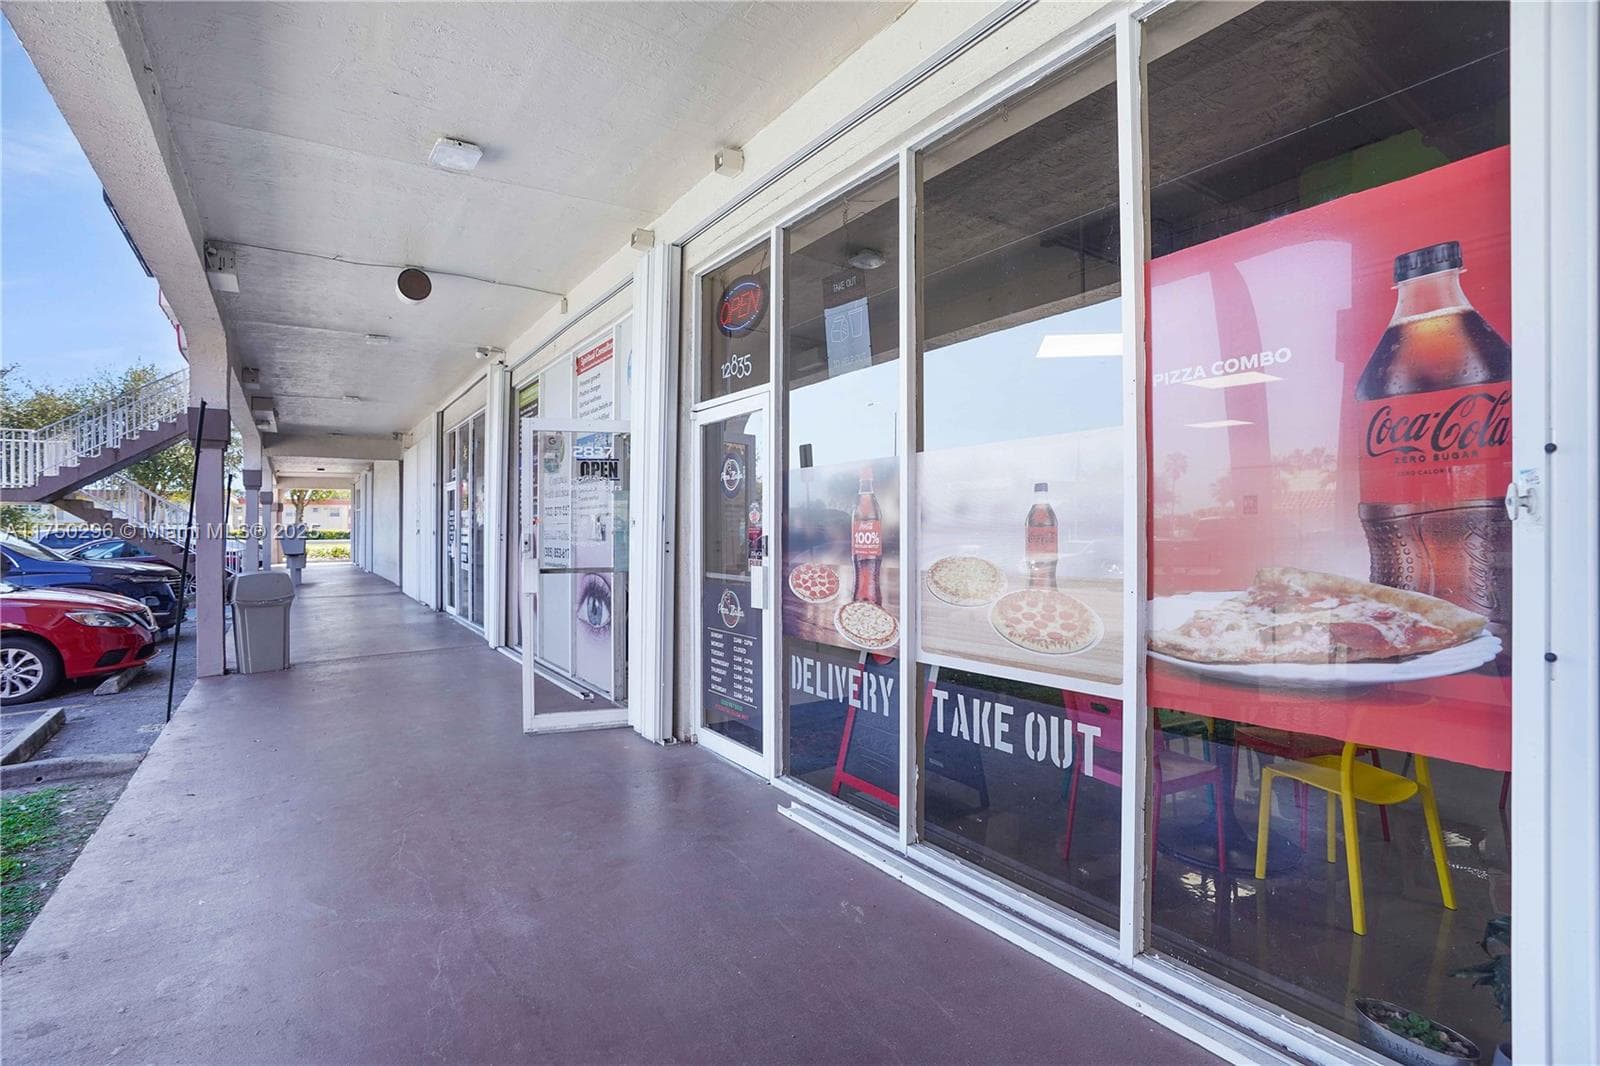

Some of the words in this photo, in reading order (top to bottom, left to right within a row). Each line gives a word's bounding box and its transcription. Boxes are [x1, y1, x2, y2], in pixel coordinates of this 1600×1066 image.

[720, 288, 761, 325] OPEN
[720, 354, 752, 378] 12835
[1153, 364, 1206, 386] PIZZA
[1211, 347, 1292, 375] COMBO
[1366, 389, 1513, 458] Coca-Cola
[580, 461, 618, 478] OPEN
[1394, 454, 1426, 464] ZERO
[1433, 450, 1480, 462] SUGAR
[854, 531, 880, 546] 100%
[733, 646, 747, 655] CLOSED
[791, 655, 894, 717] DELIVERY
[932, 688, 1014, 755] TAKE
[1025, 711, 1102, 777] OUT
